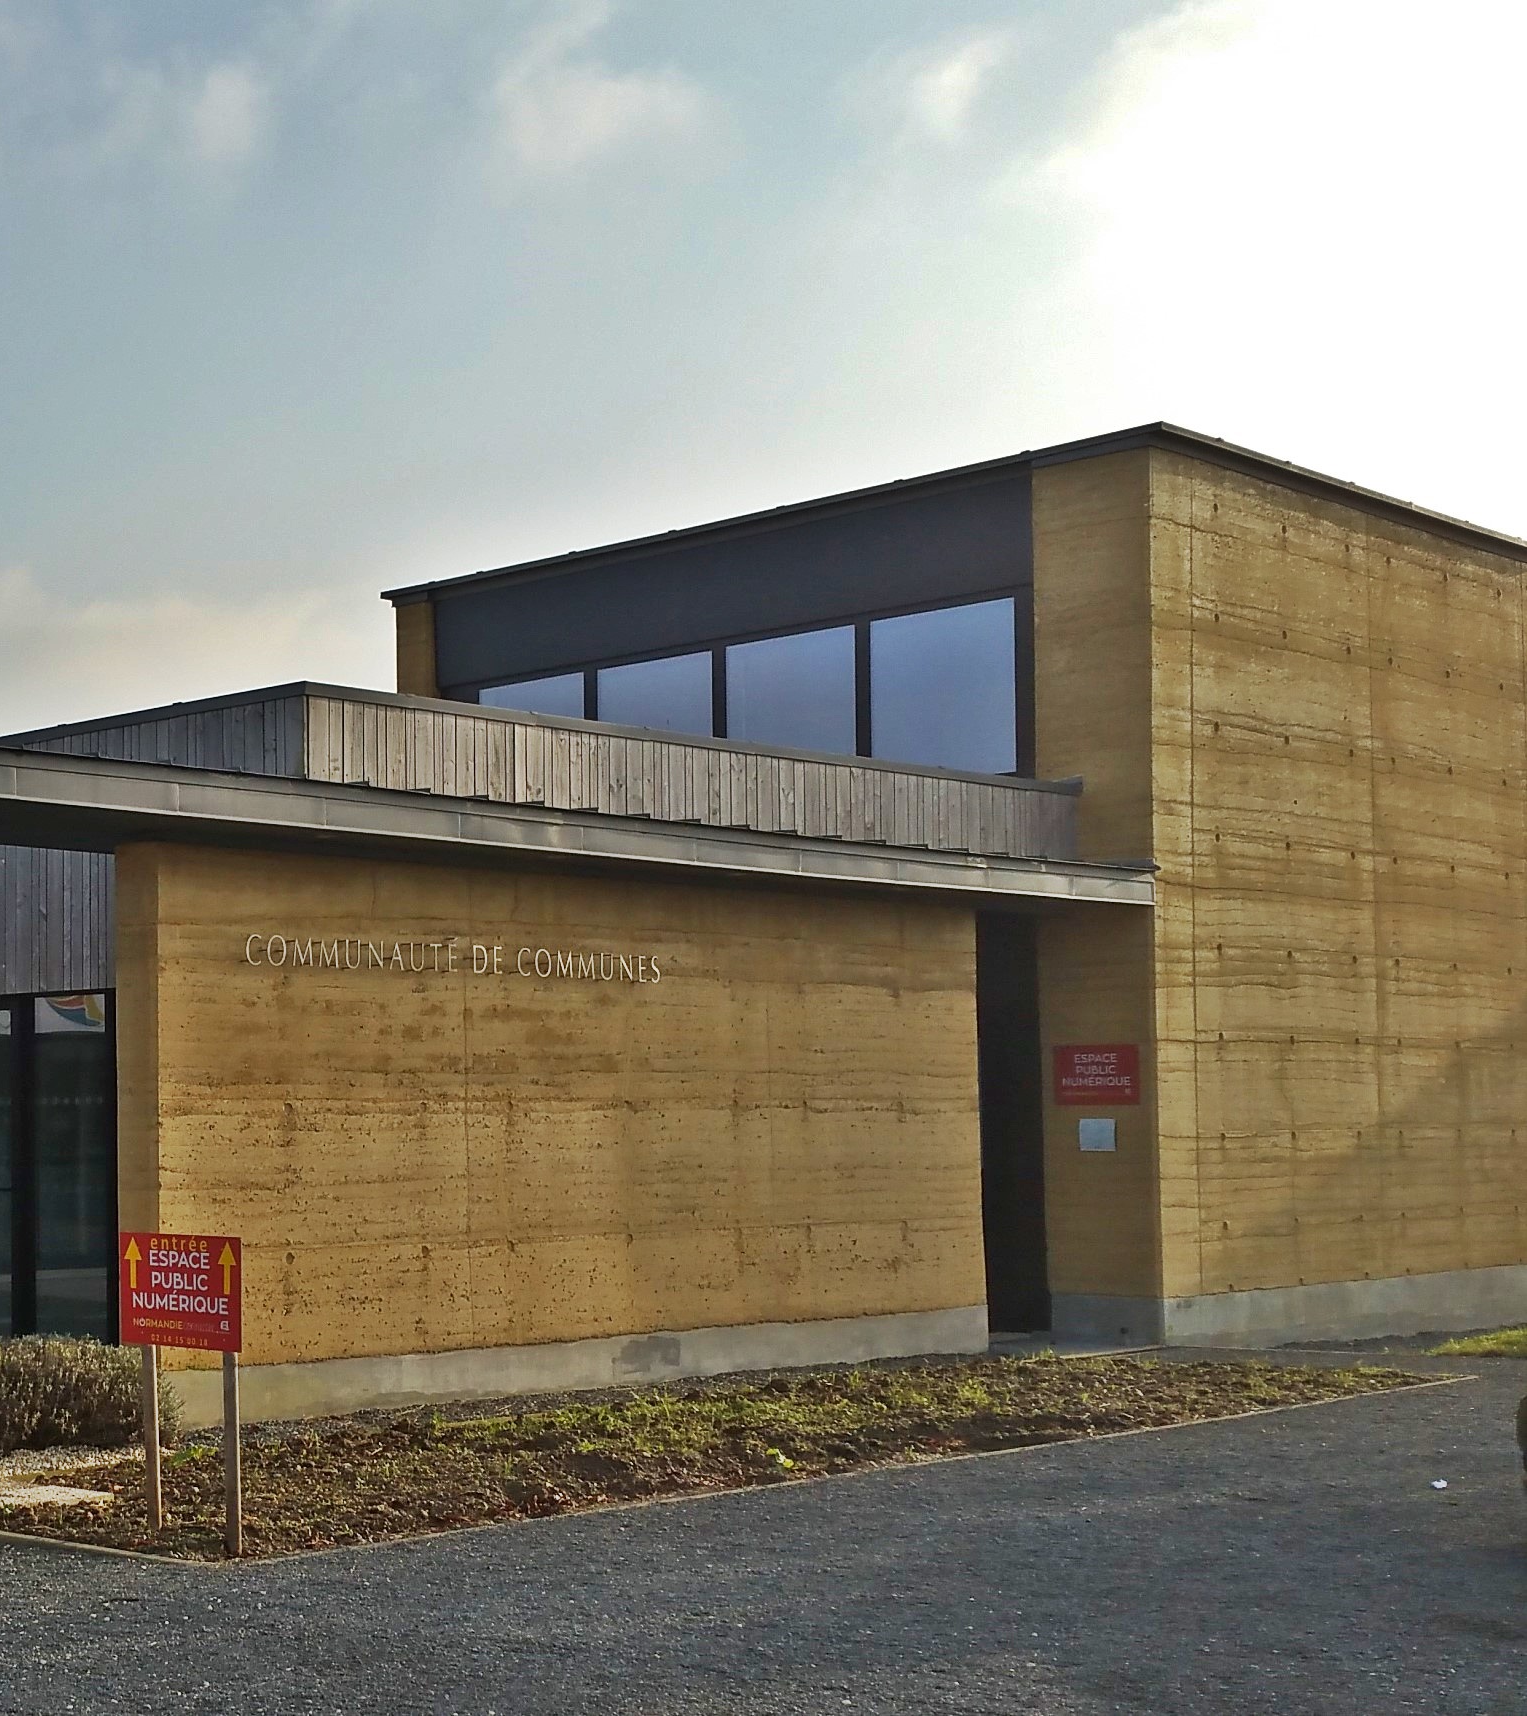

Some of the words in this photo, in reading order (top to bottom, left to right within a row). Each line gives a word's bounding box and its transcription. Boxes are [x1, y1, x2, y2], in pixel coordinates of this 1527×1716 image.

[245, 934, 459, 973] COMMUNAUTÉ
[473, 944, 503, 974] DE
[517, 947, 662, 984] COMMUNES
[1074, 1053, 1118, 1064] ESPACE
[1075, 1065, 1116, 1075] PUBLIC
[150, 1236, 208, 1252] entrée
[149, 1249, 211, 1270] ESPACE
[151, 1271, 209, 1292] PUBLIC
[132, 1290, 229, 1316] NUMÉRIQUE
[133, 1318, 184, 1330] NORMANDIE
